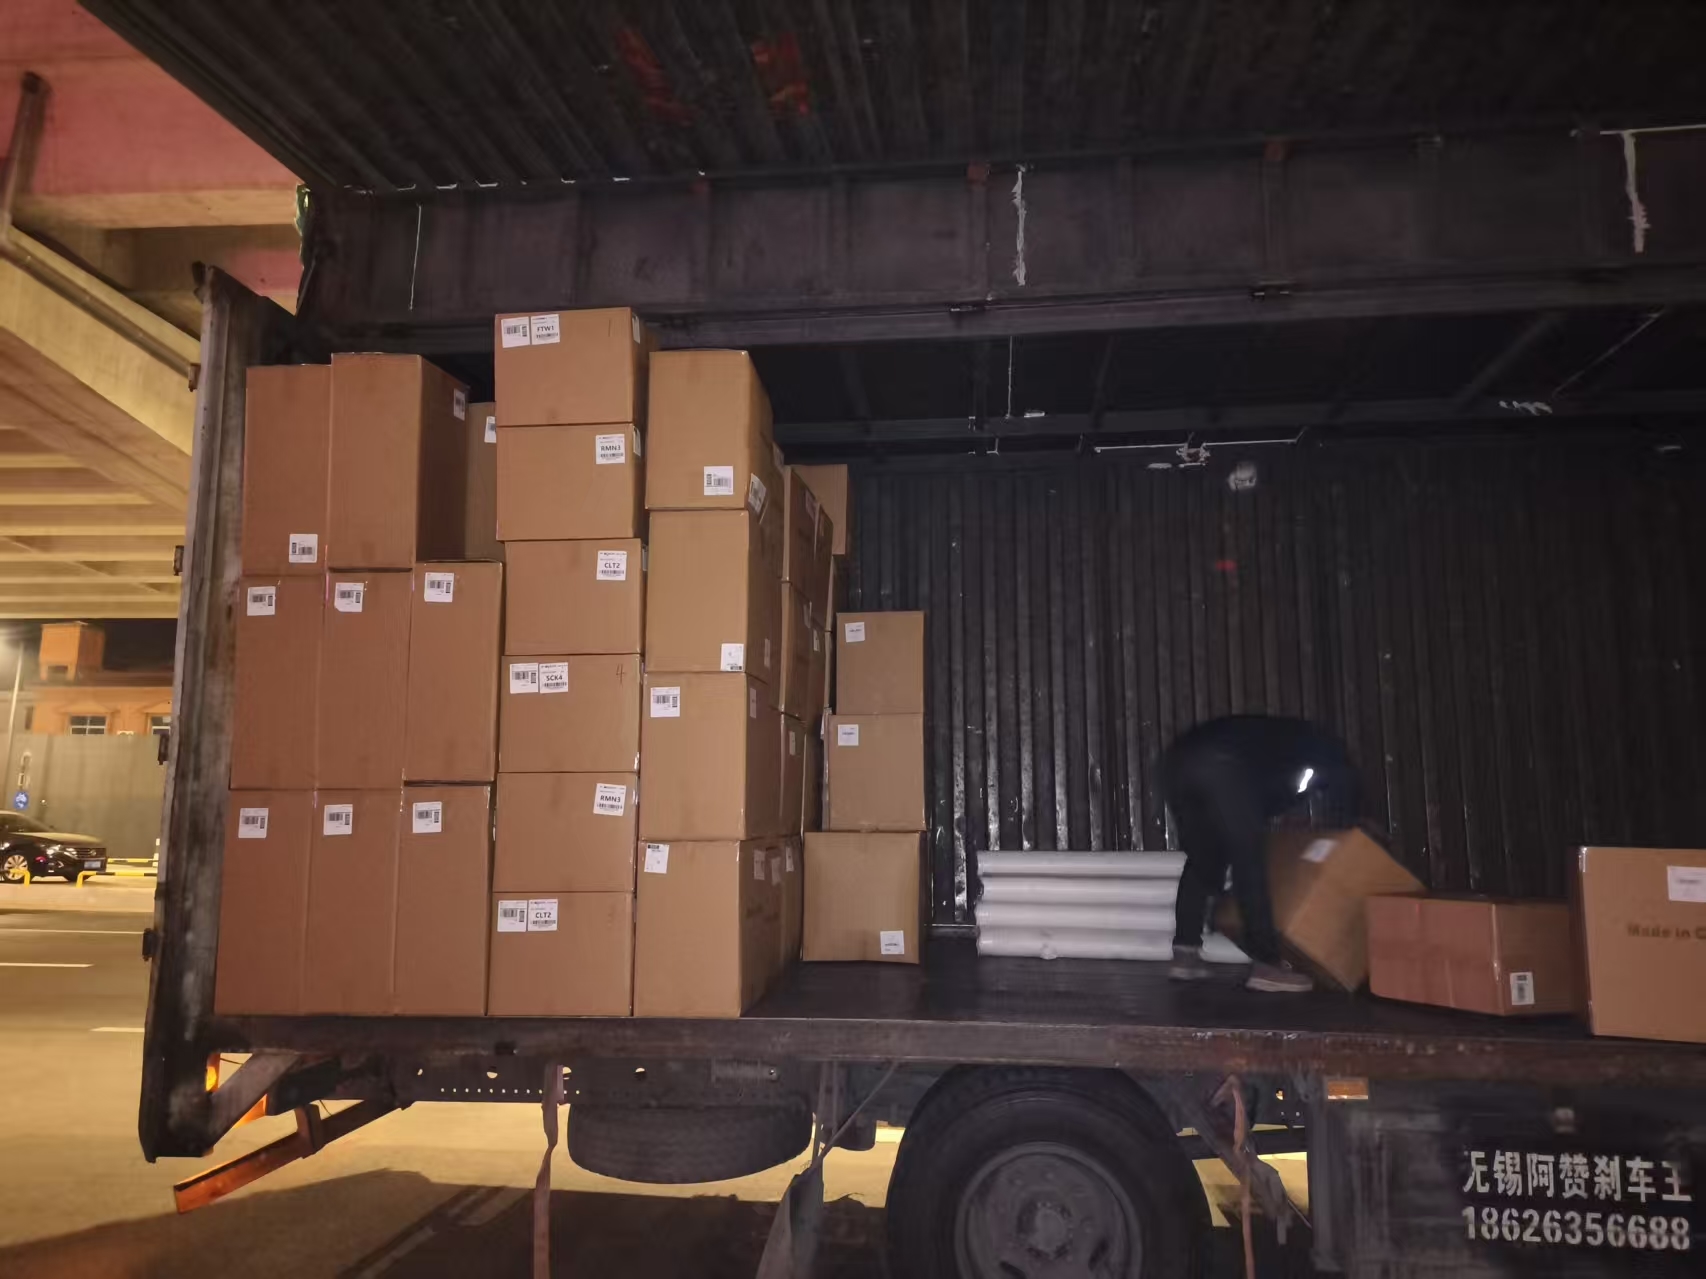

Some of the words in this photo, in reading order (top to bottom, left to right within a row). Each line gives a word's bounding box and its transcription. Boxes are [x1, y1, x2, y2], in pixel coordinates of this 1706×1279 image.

[537, 325, 554, 333] FTW1
[600, 444, 621, 452] RMN3
[546, 674, 563, 682] SCK4
[600, 794, 621, 803] RMN3
[535, 911, 552, 919] CLT2
[1627, 924, 1670, 938] Made
[1675, 927, 1691, 938] in
[1463, 1150, 1692, 1203] 无锡阿赞刹车王
[1462, 1206, 1690, 1250] 18626356688
